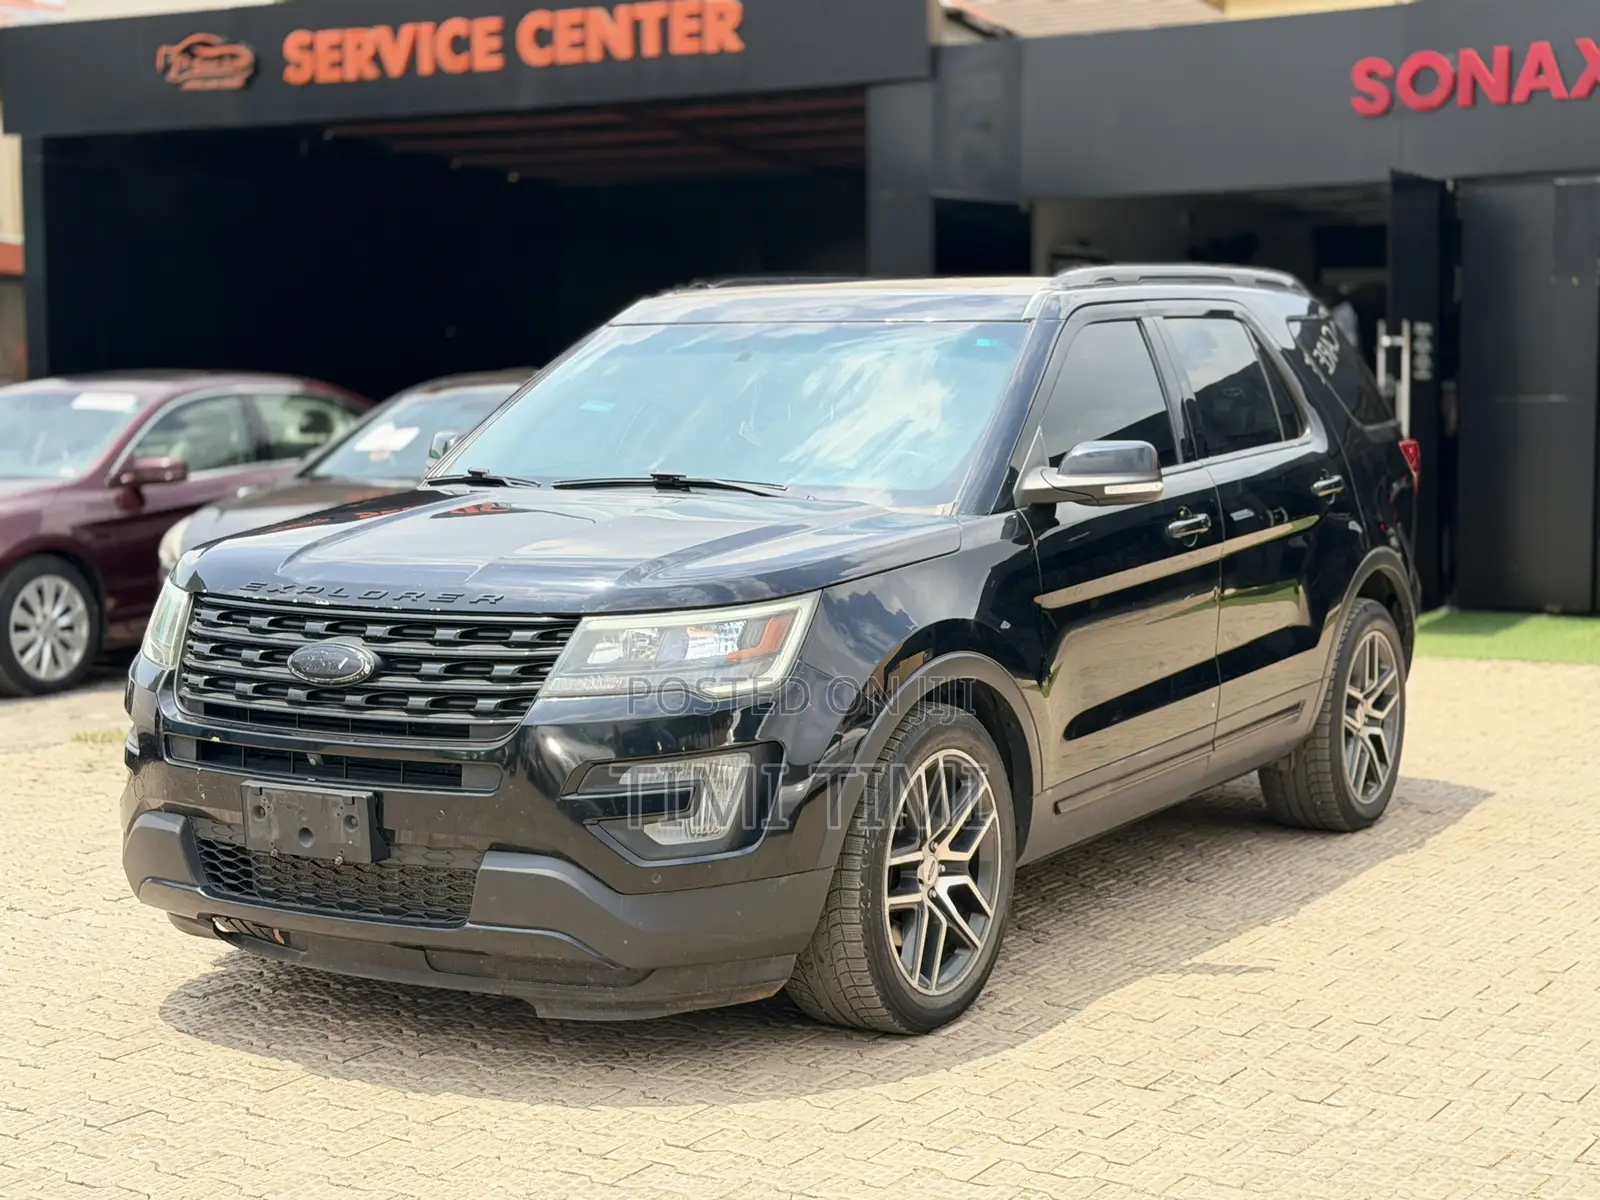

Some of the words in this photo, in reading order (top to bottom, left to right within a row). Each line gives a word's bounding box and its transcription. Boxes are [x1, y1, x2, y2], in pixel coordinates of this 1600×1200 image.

[282, 16, 505, 85] SERVICE
[514, 0, 745, 67] CENTER
[239, 581, 505, 605] EXPLORER
